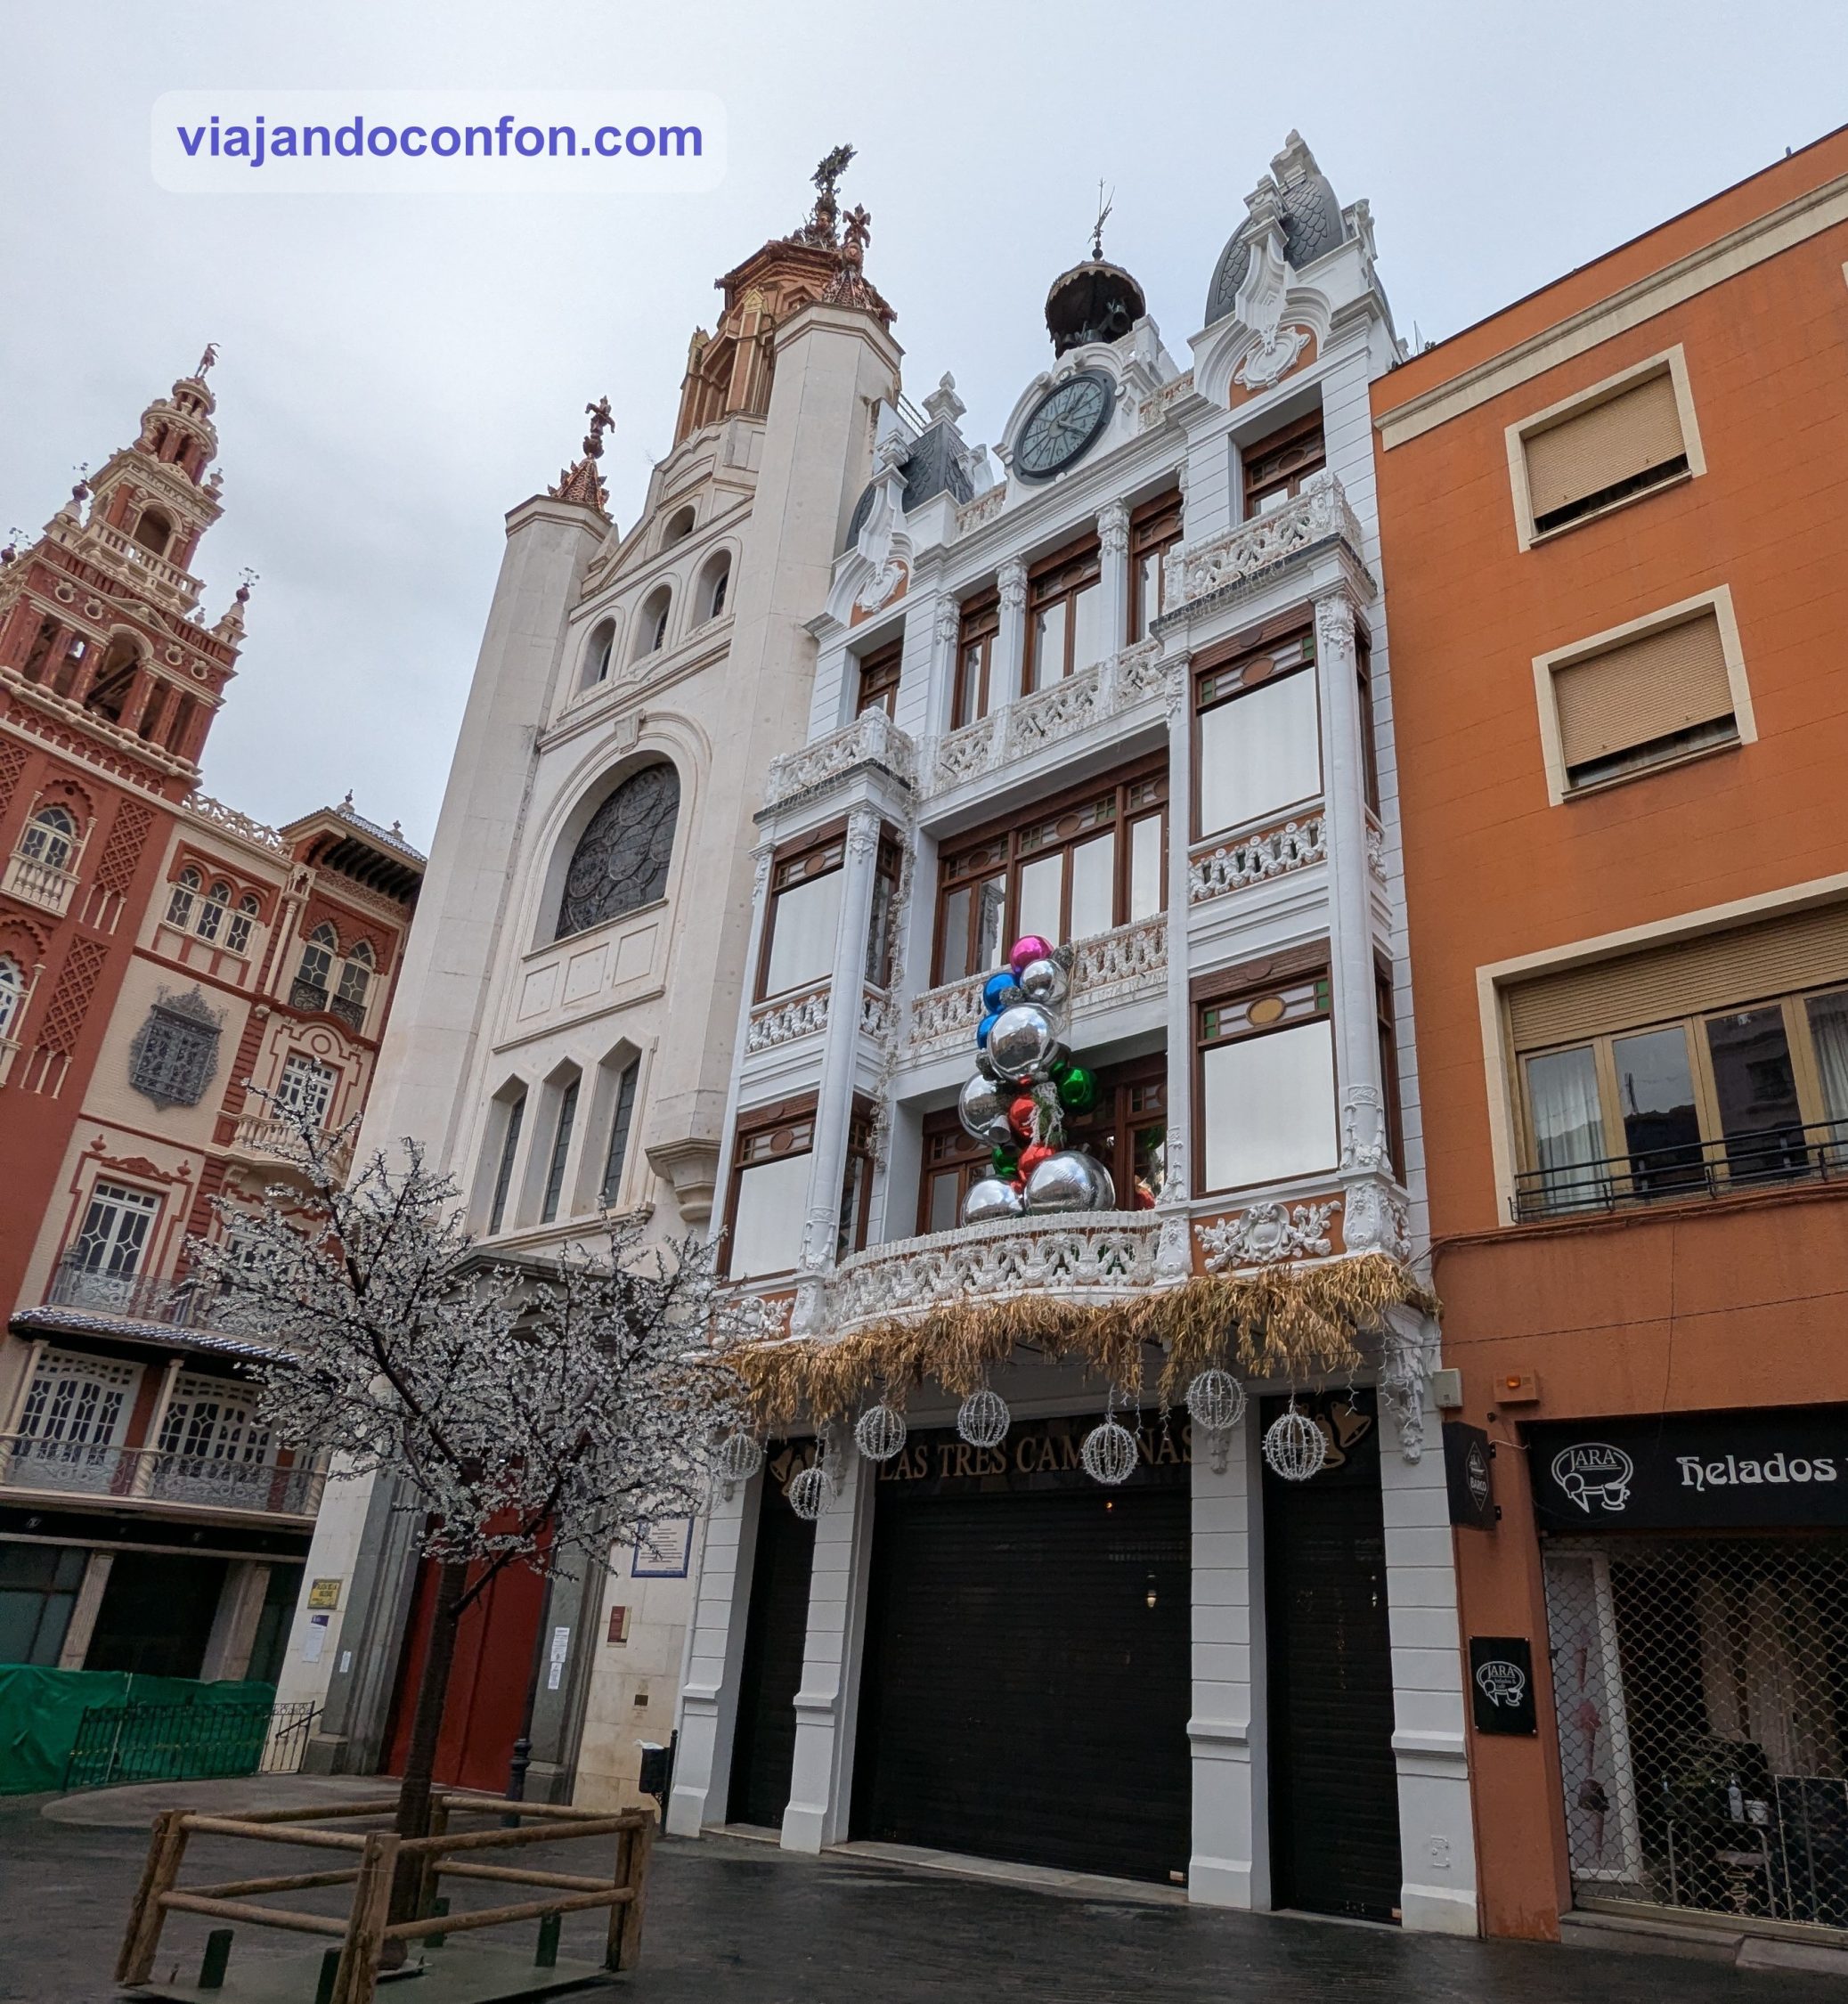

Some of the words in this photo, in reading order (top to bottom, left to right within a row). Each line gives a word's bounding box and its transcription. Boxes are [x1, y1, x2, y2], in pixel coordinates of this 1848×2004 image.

[878, 1444, 928, 1481] LAS
[938, 1440, 1008, 1477] TRES
[1016, 1425, 1192, 1472] CAMNAS
[1569, 1448, 1616, 1472] JARA
[1487, 1665, 1516, 1679] JARA
